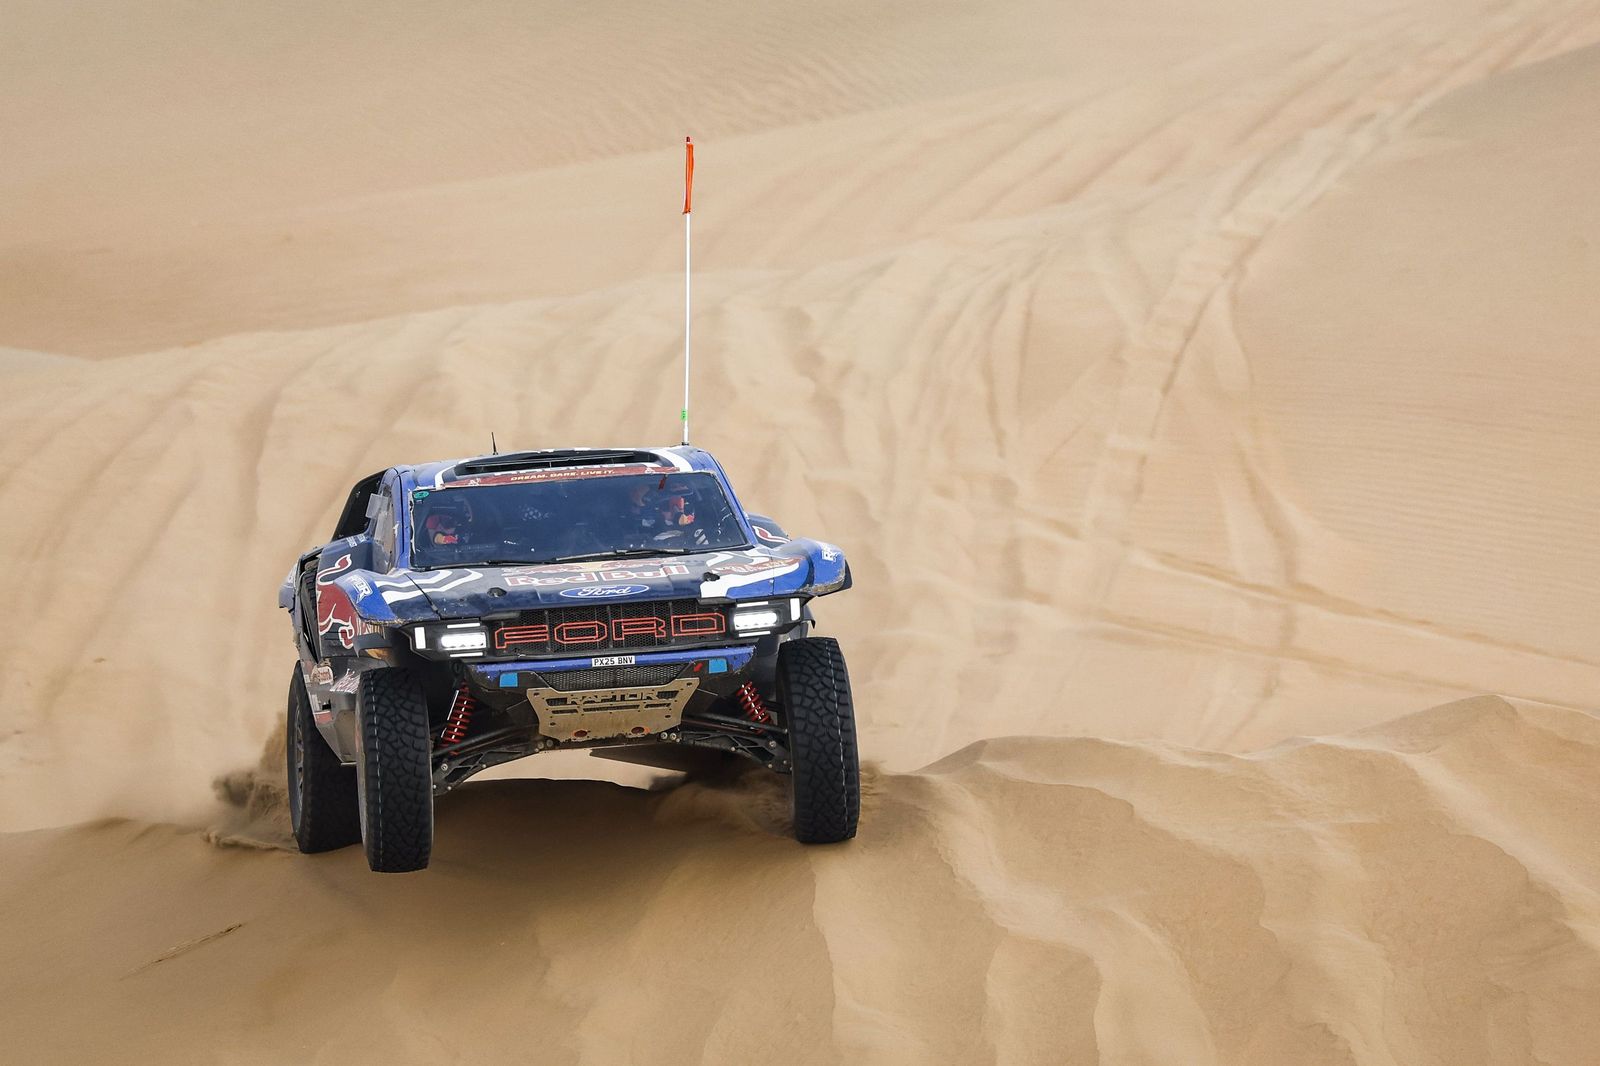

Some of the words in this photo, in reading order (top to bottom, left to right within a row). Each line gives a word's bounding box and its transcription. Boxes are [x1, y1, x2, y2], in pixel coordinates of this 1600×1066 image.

[505, 571, 599, 587] Red
[601, 564, 690, 582] Bull
[578, 586, 634, 598] Ford
[495, 613, 726, 649] FORD
[593, 658, 616, 666] PX25
[617, 656, 633, 665] BNV
[567, 690, 658, 705] RAPTOR
